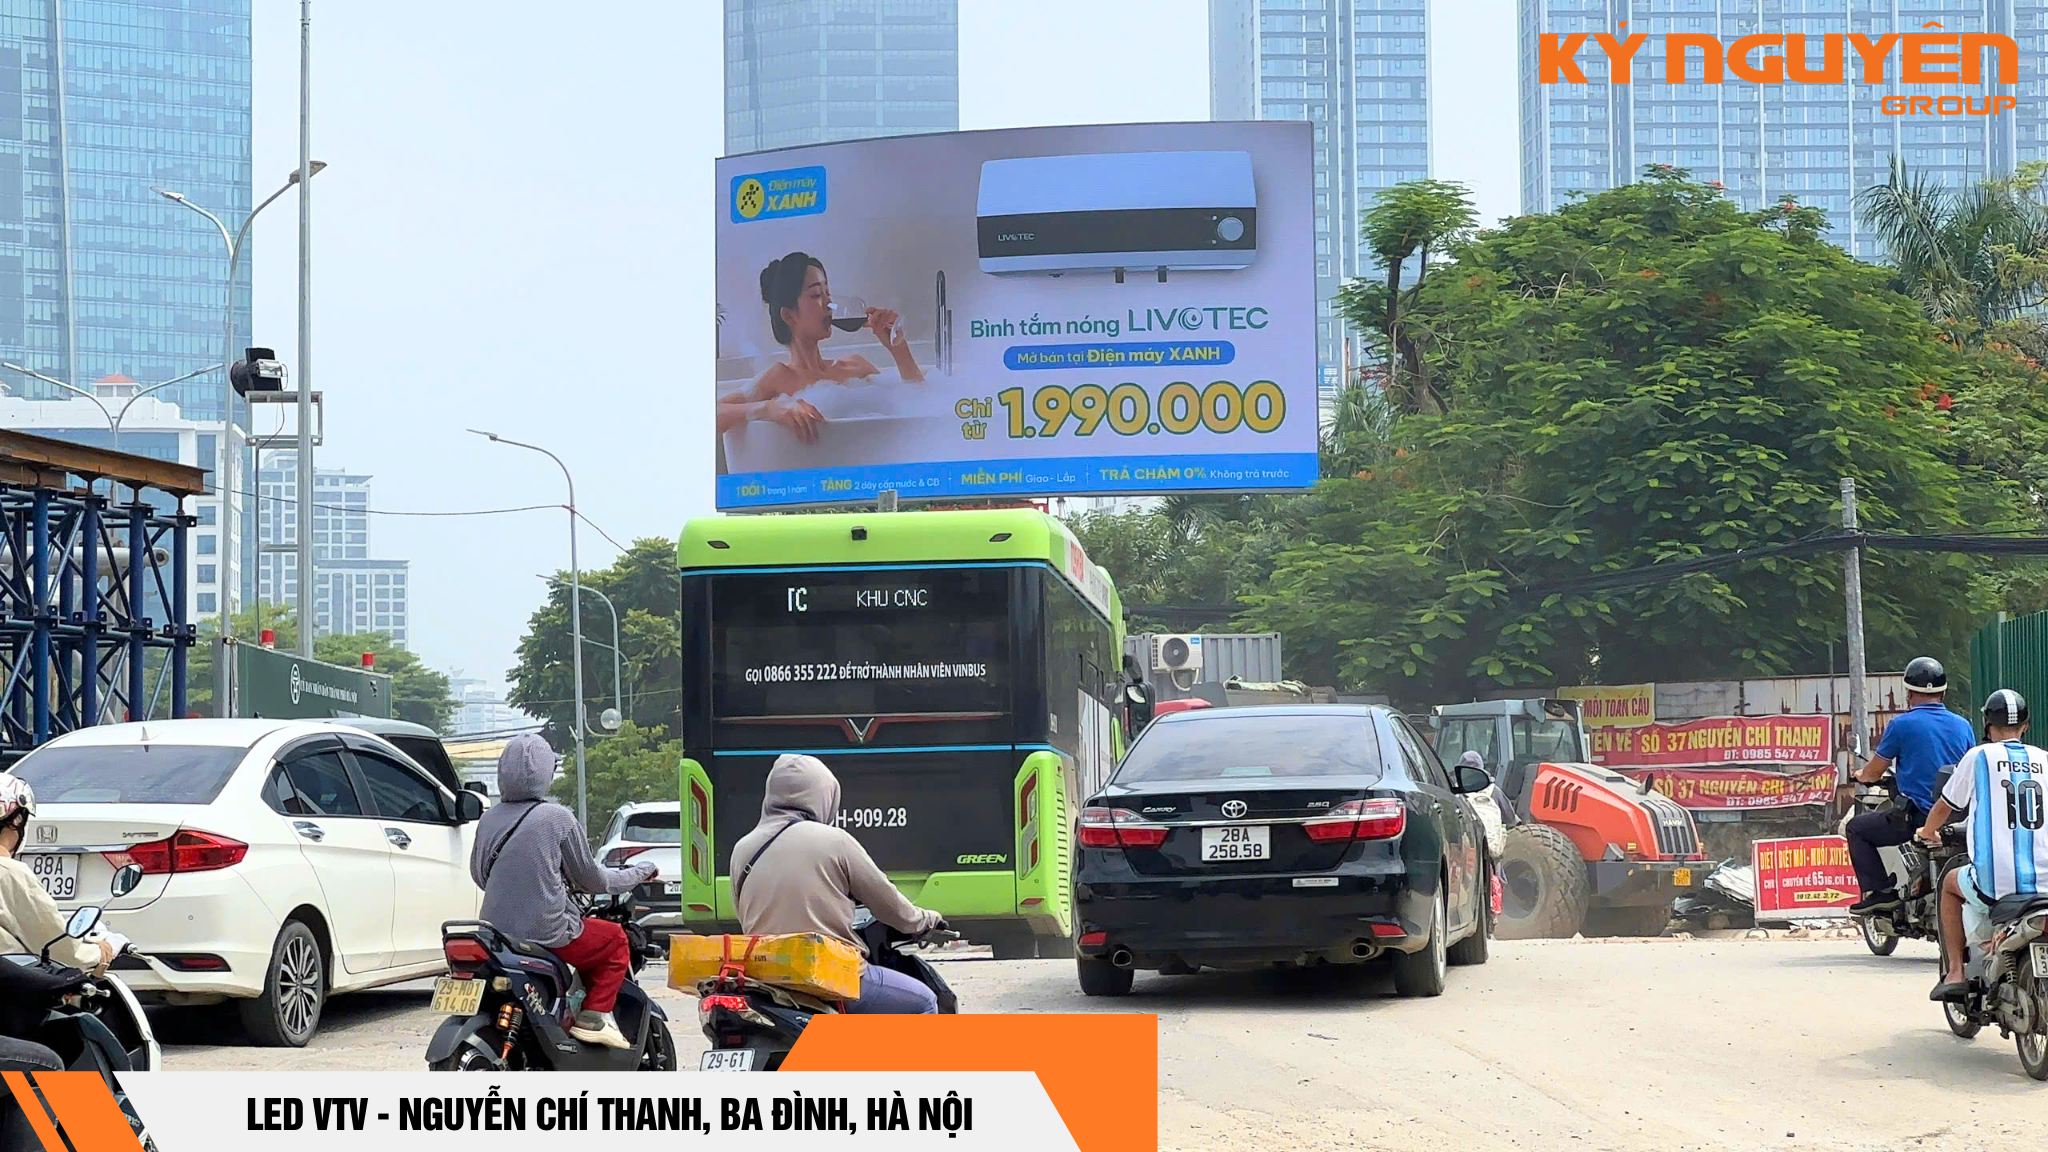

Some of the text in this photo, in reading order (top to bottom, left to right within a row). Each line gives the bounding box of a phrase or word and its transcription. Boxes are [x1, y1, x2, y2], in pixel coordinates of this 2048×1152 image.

[767, 191, 818, 211] XANH
[998, 233, 1035, 242] LIVOTEC
[970, 306, 1269, 338] Bình tắm nóng LIVOTEC
[1017, 346, 1221, 366] Mở bán tại Điện máy XANH
[998, 380, 1286, 439] 1.990.000
[962, 420, 987, 439] từ
[1184, 467, 1206, 480] 0%
[854, 482, 860, 490] 2
[926, 478, 940, 486] CB
[856, 590, 889, 608] KHU
[894, 588, 928, 607] CNC
[745, 668, 762, 686] GỌI
[764, 665, 792, 682] 0866
[793, 664, 814, 681] 355
[816, 663, 837, 680] 222
[903, 661, 930, 679] NHÂN
[930, 661, 951, 678] VIÊN
[952, 663, 986, 678] VINBUS
[1641, 729, 1659, 753] SỐ
[1667, 731, 1688, 750] 37
[1688, 721, 1742, 750] NGUYỄN
[1746, 721, 1770, 747] CHÍ
[1775, 725, 1822, 748] THANH
[1742, 748, 1772, 760] 0985
[1774, 748, 1796, 760] 547
[1798, 748, 1820, 760] 447
[1997, 760, 2043, 774] MESSI
[1678, 779, 1695, 799] 37
[1748, 795, 1779, 806] 0985
[2001, 779, 2044, 830] 10
[829, 806, 907, 829] H-909.28
[1221, 828, 1250, 842] 28A
[956, 854, 1008, 864] GREEN
[1209, 844, 1262, 859] 258.58
[33, 856, 63, 876] 88A
[40, 876, 74, 896] 0.39
[1812, 871, 1824, 886] 65
[434, 996, 476, 1012] 614.06
[707, 1052, 745, 1069] 29-G1
